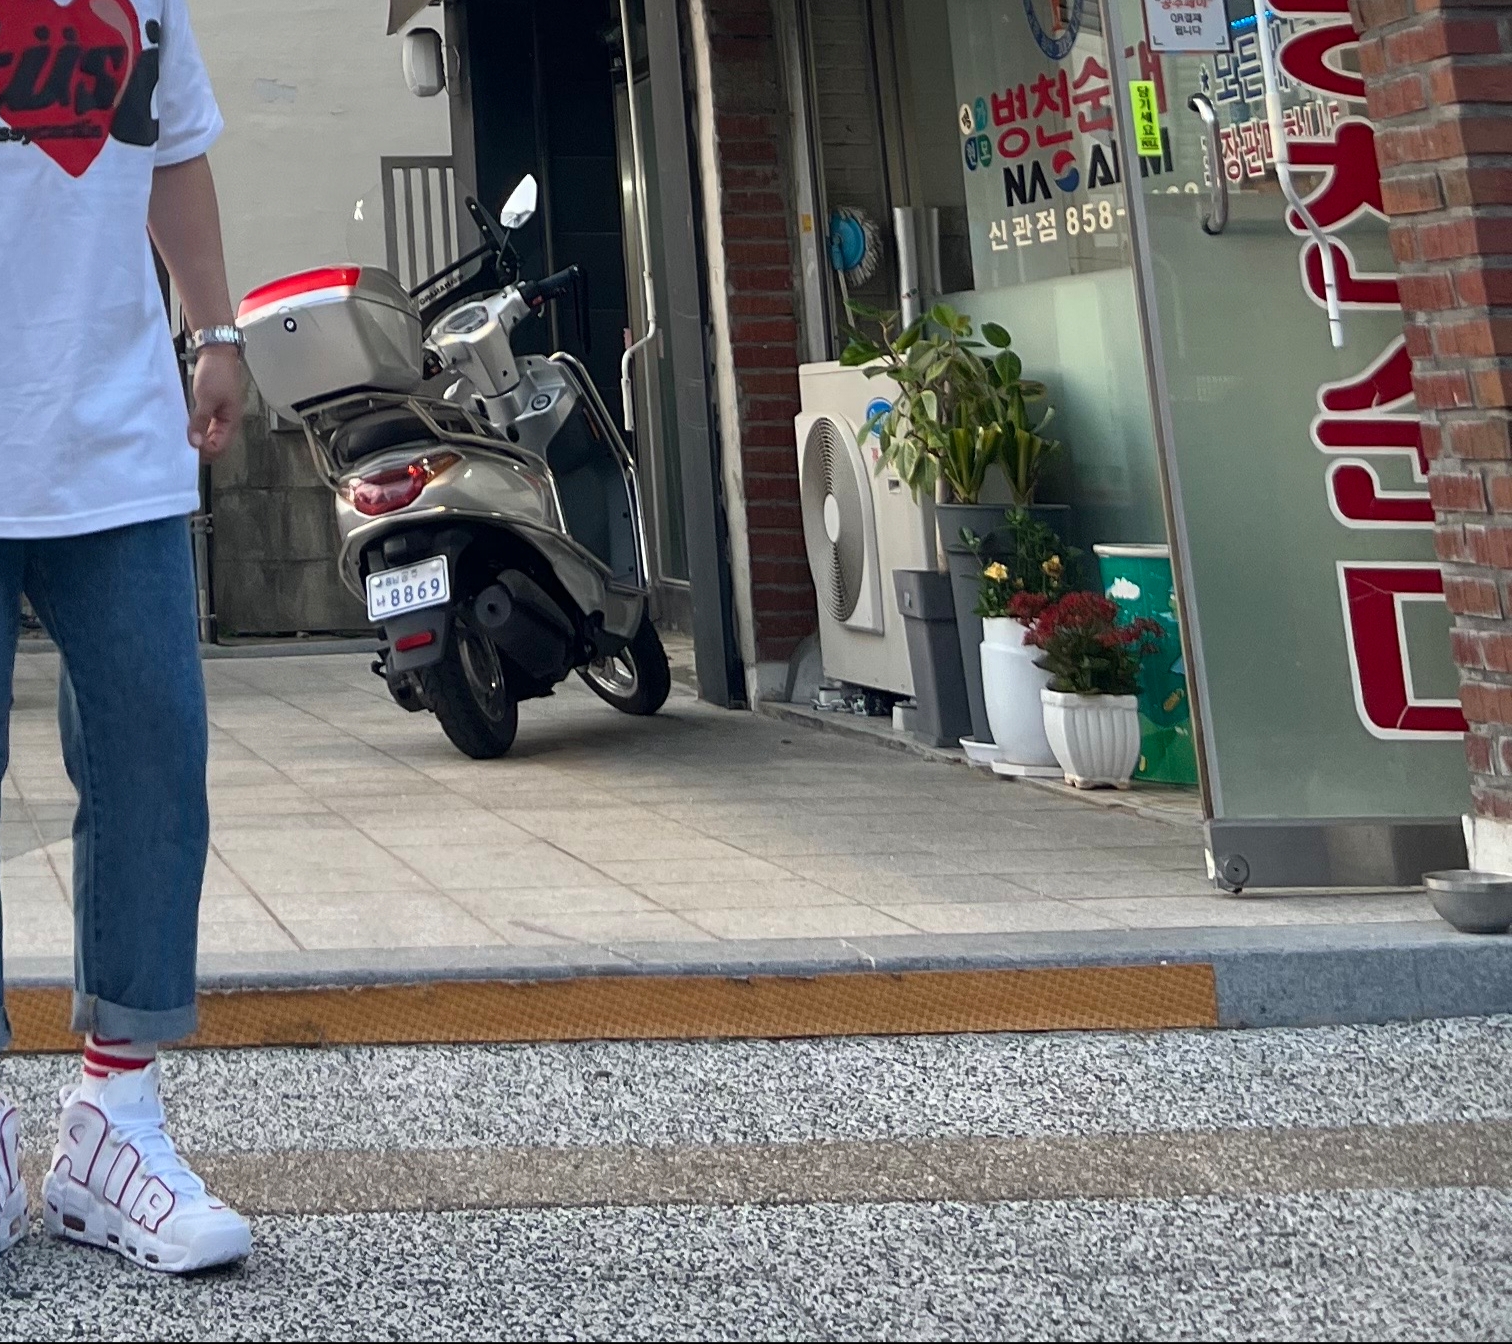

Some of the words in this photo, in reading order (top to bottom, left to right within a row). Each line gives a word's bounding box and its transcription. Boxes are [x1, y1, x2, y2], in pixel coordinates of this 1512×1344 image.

[988, 207, 1059, 252] 신관점
[390, 577, 440, 607] 8869
[52, 1101, 176, 1233] AIR
